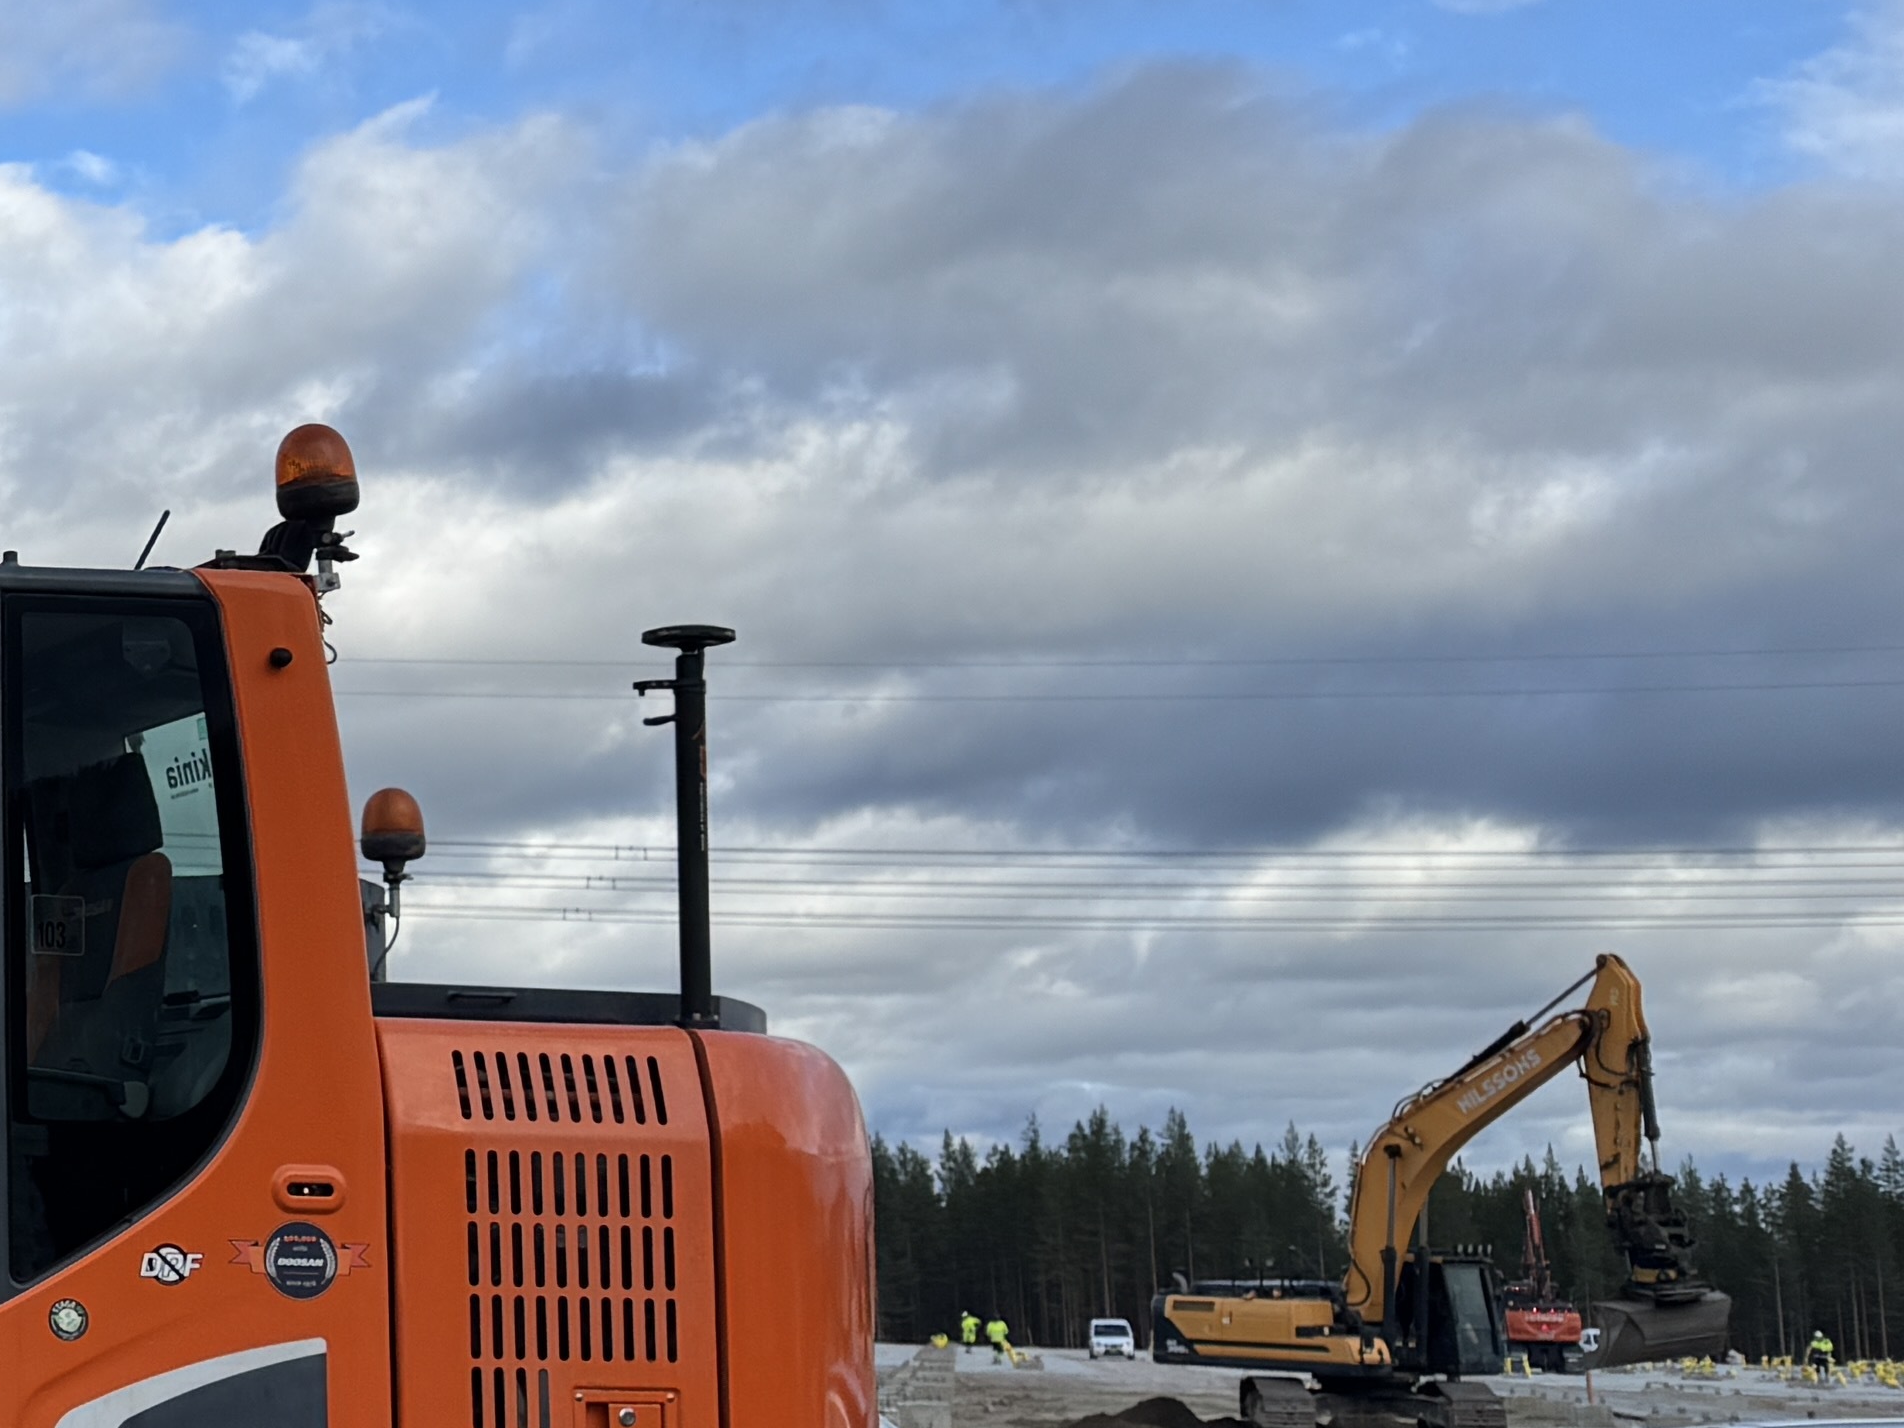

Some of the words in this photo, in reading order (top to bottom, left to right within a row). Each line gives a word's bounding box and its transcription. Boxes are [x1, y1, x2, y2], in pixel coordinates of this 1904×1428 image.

[37, 920, 66, 949] 103
[140, 1249, 204, 1279] DPF
[277, 1257, 324, 1267] DOOSAN
